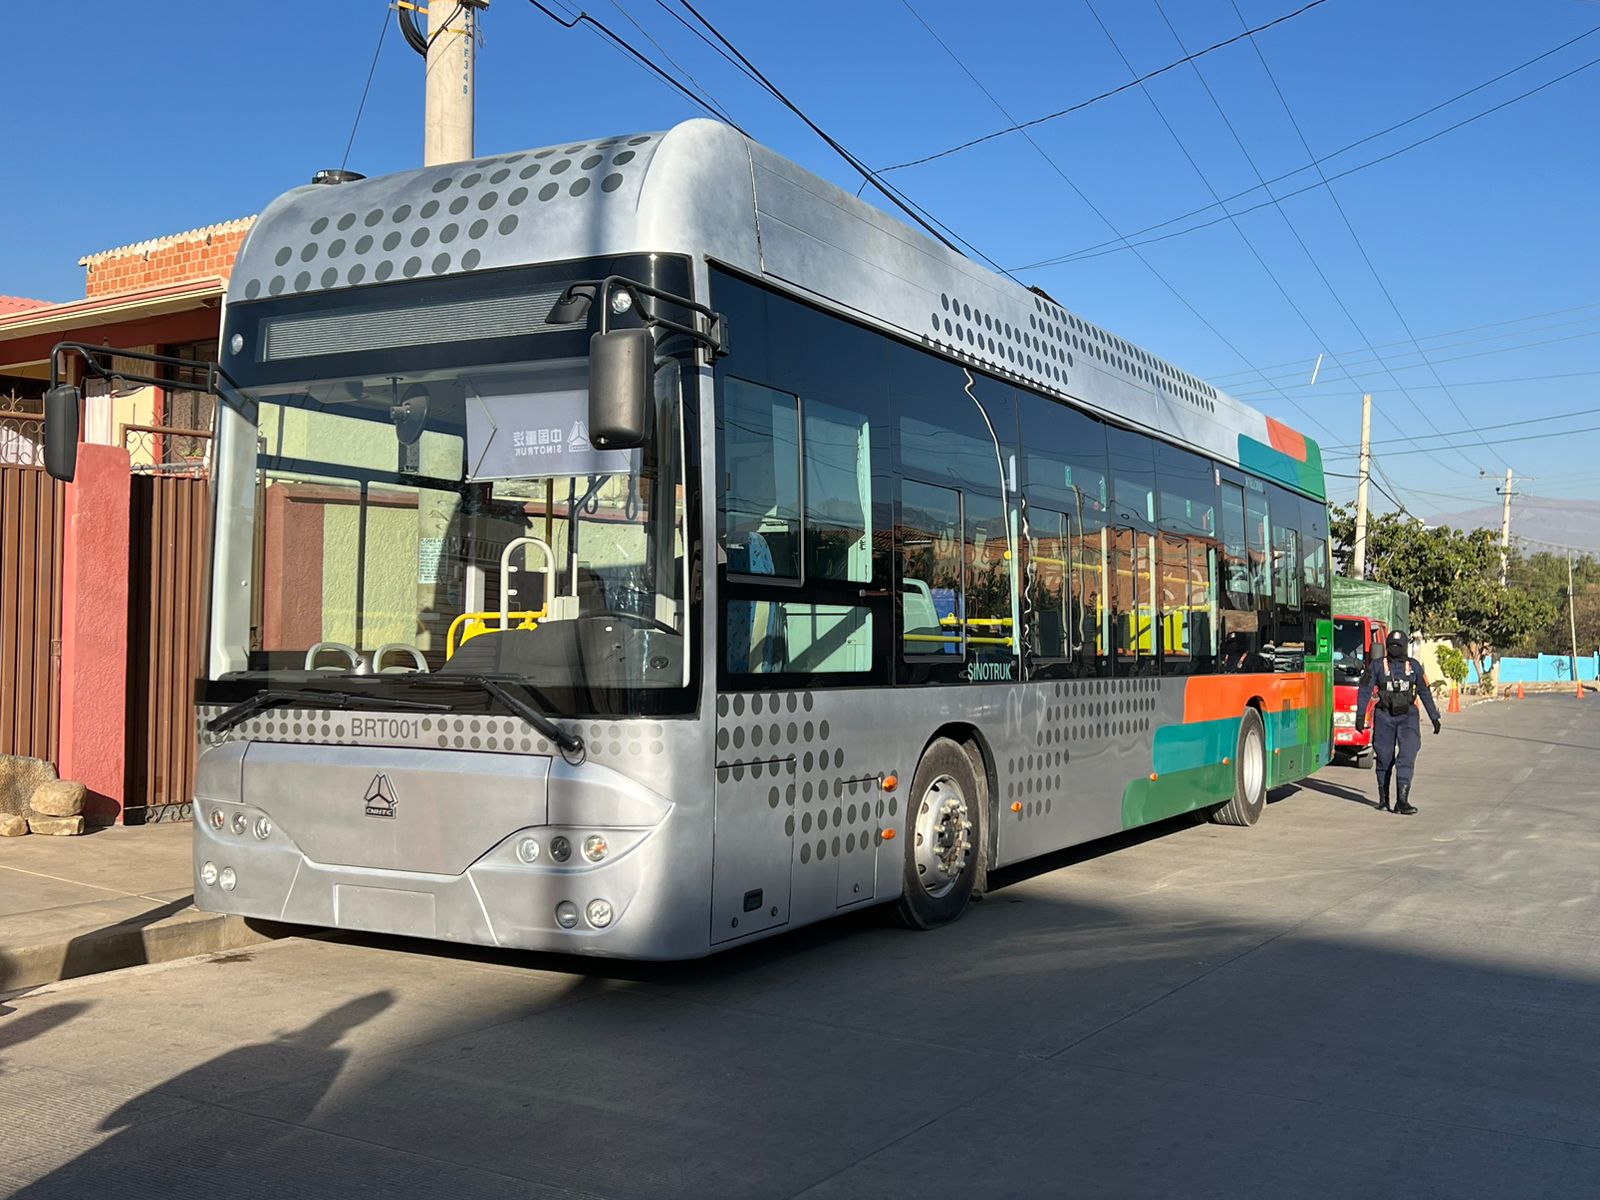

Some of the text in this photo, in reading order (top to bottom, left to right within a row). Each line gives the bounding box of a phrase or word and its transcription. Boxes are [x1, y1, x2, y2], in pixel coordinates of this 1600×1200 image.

[968, 662, 1011, 681] SINOTRUK
[351, 717, 418, 739] BRT001
[366, 807, 393, 816] CNHTC
